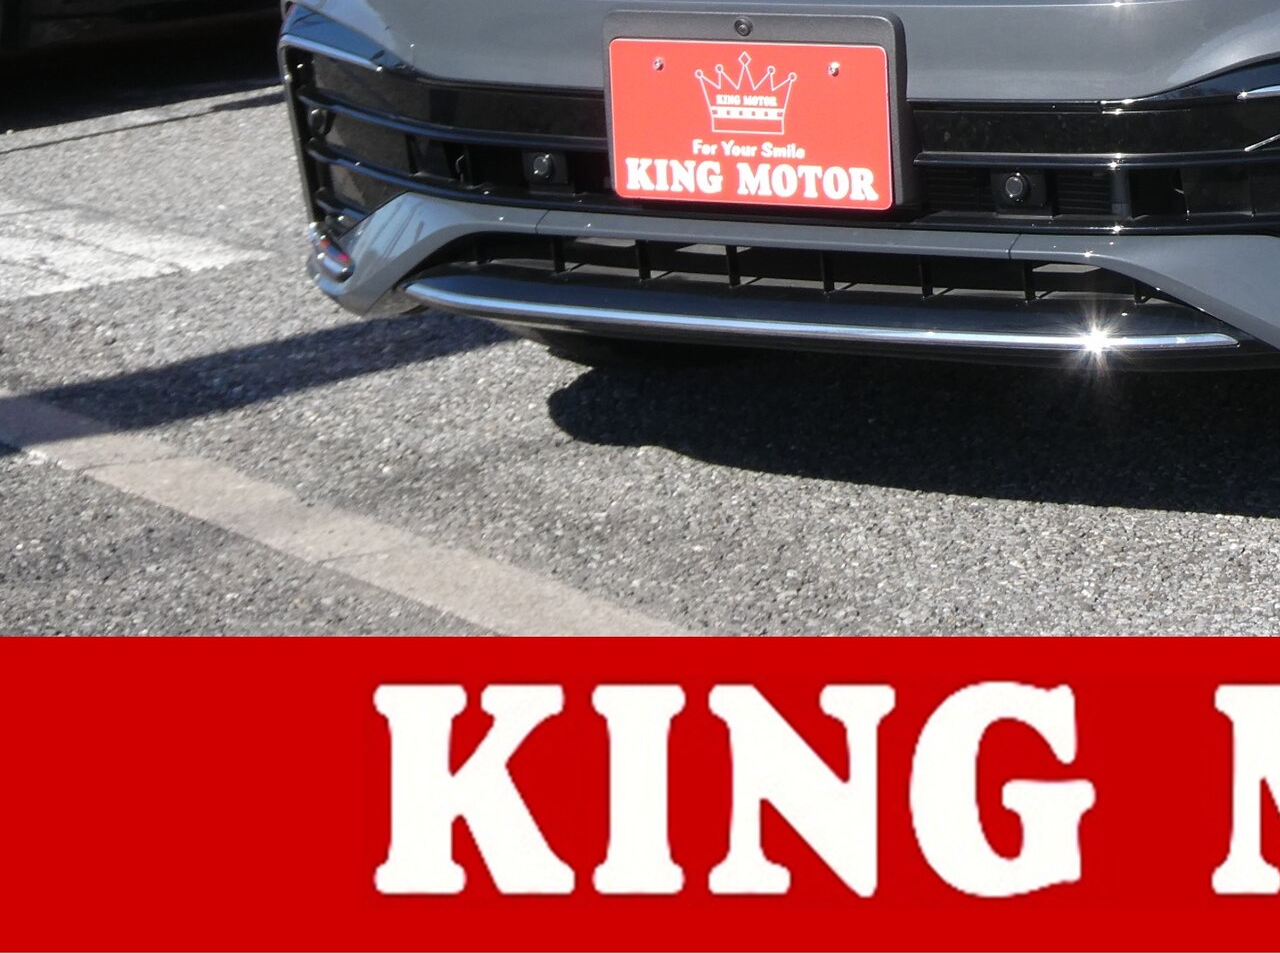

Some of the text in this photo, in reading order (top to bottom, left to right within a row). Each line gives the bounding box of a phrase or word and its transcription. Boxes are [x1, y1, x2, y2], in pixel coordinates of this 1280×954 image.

[716, 94, 778, 107] KING MOTOR
[692, 138, 806, 159] For Your Smile
[625, 157, 880, 201] KING MOTOR
